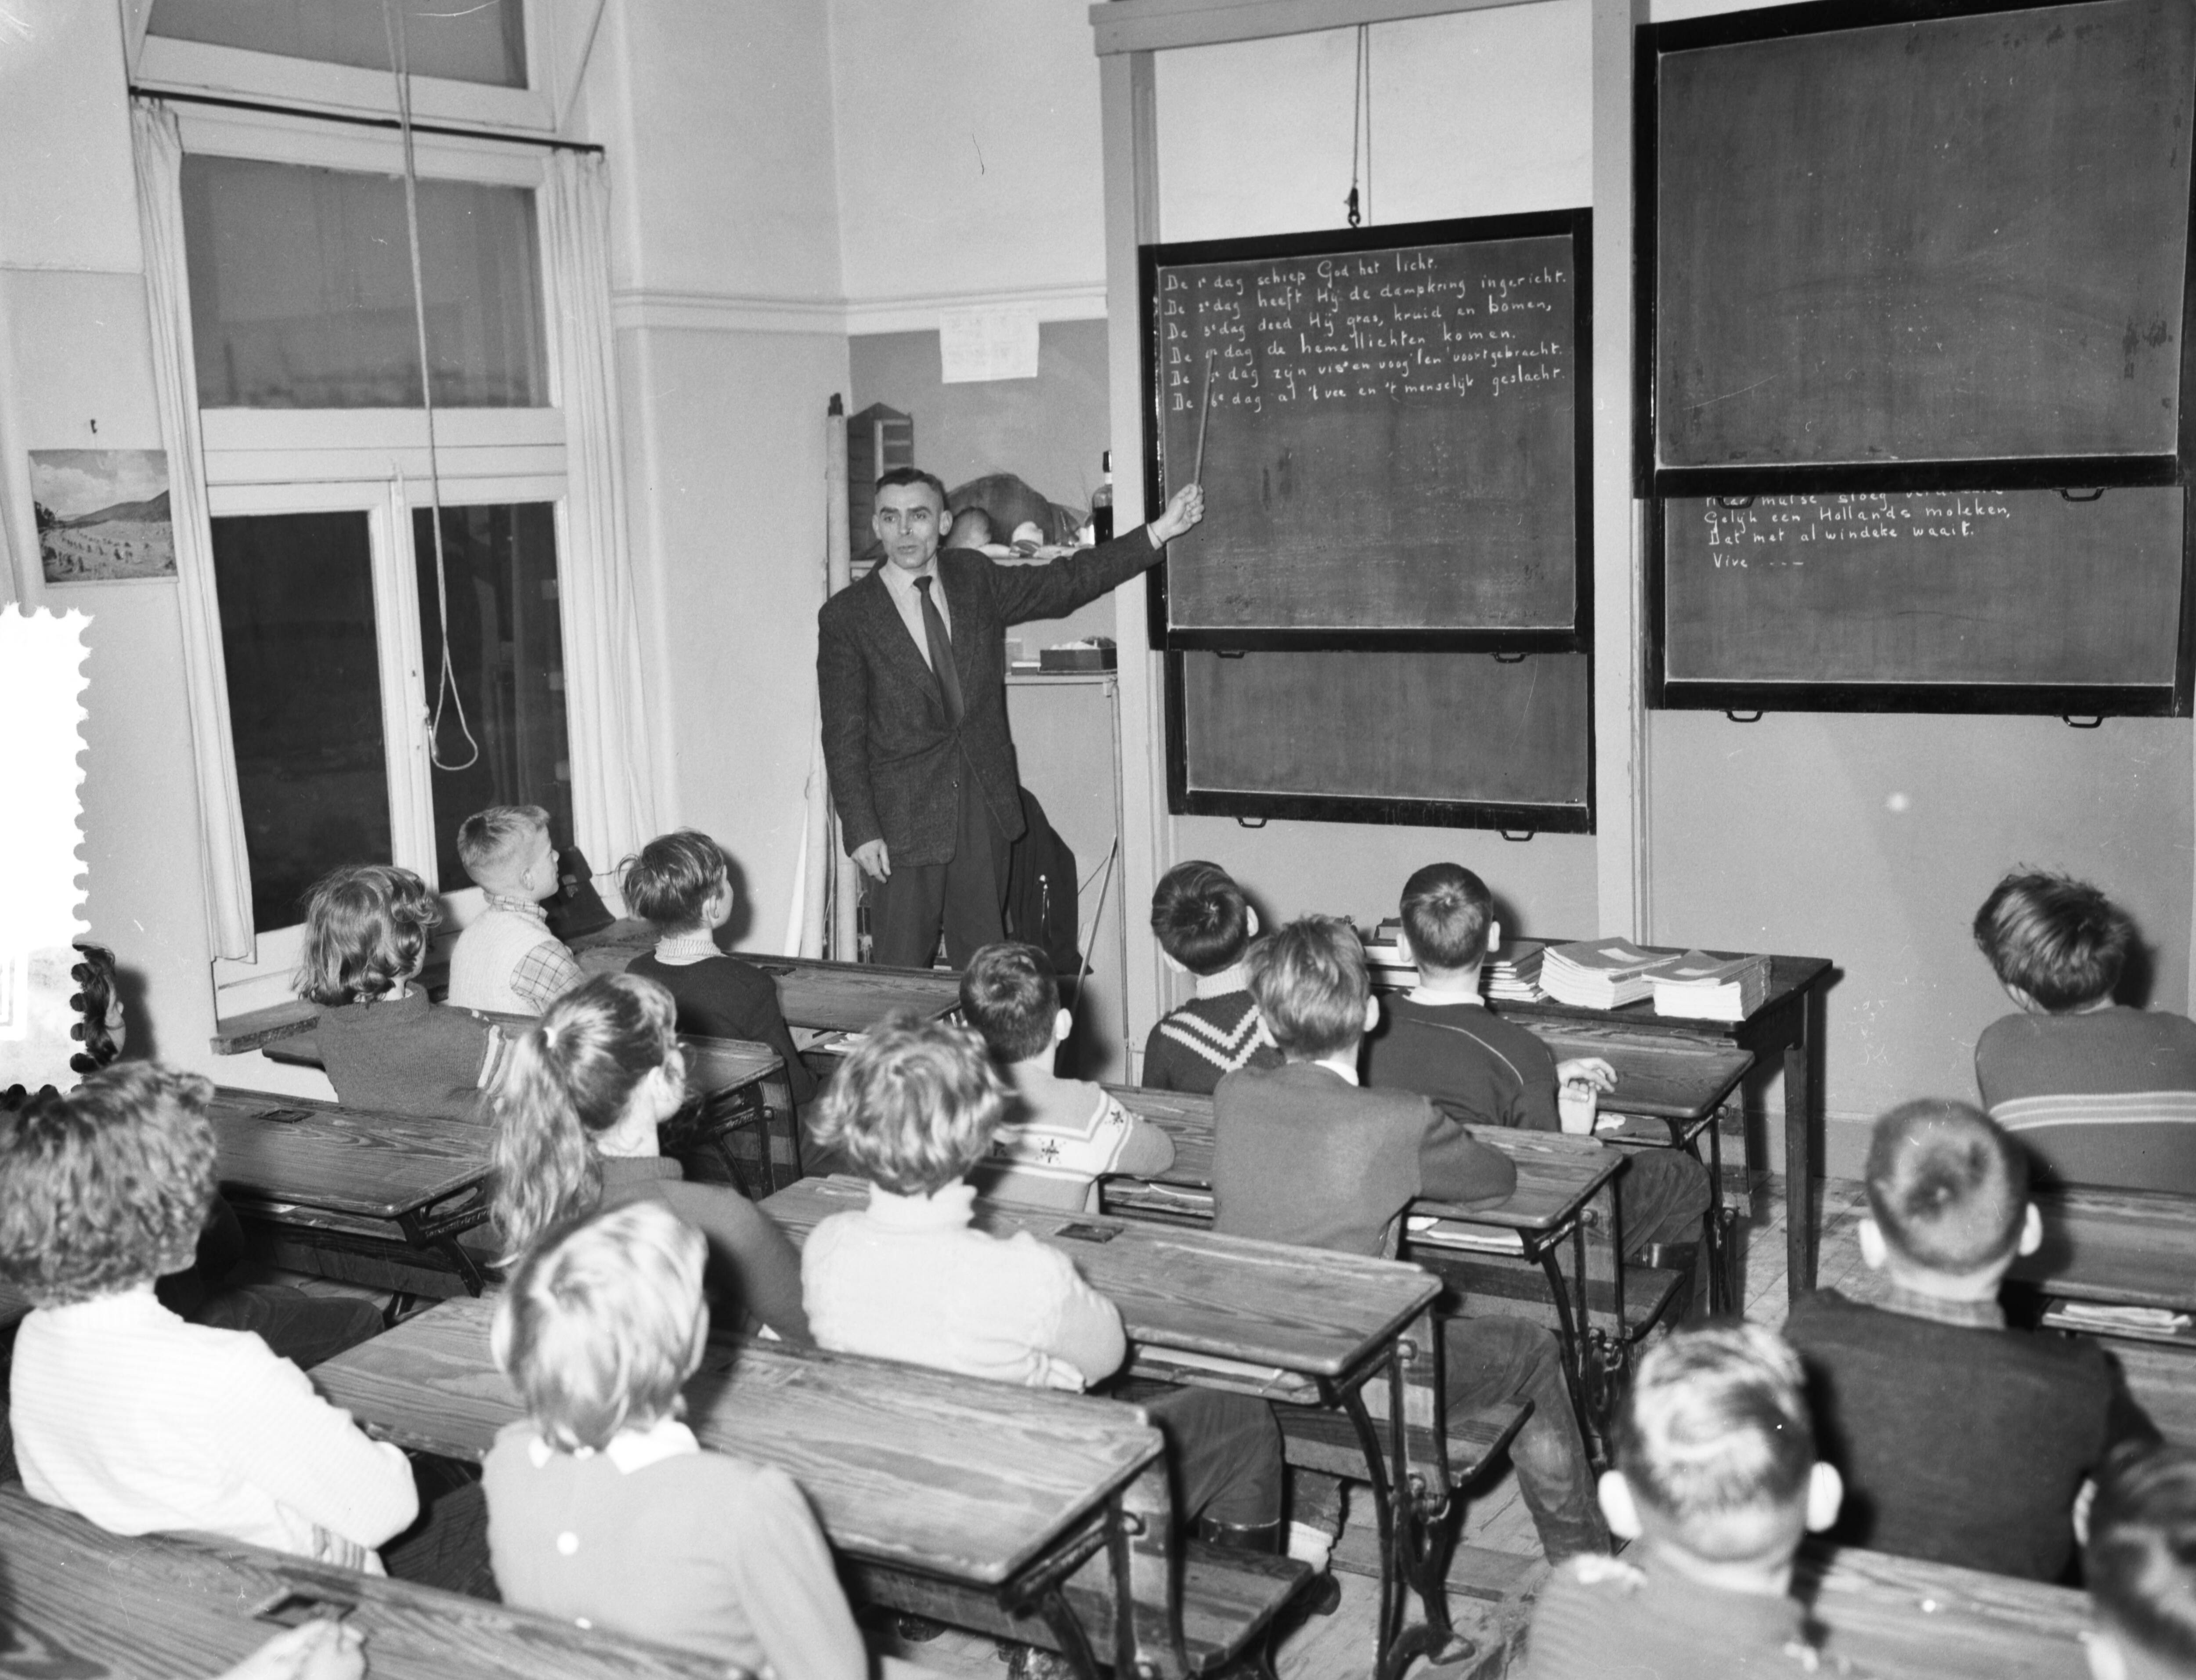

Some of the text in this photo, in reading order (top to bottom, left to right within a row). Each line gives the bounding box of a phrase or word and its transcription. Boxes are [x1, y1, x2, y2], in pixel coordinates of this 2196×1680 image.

[1164, 299, 1185, 315] De
[1214, 299, 1240, 320] dag
[1257, 286, 1301, 311] heeft
[1350, 286, 1370, 300] de
[1380, 275, 1465, 299] dampkring
[1481, 266, 1566, 298] ingericht.
[1165, 275, 1188, 291] De
[1214, 275, 1243, 296] dag
[1257, 267, 1306, 285] schiep
[1317, 260, 1349, 289] God
[1359, 258, 1380, 275] het
[1397, 252, 1438, 272] licht.
[1167, 323, 1188, 340] De
[1220, 321, 1246, 342] dag
[1258, 318, 1292, 331] deed
[1347, 314, 1383, 338] gras,
[1394, 302, 1442, 321] kruid
[1458, 307, 1475, 316] en
[1489, 294, 1551, 314] bomen,
[1170, 347, 1192, 364] De
[1224, 344, 1253, 366] dag
[1268, 340, 1286, 354] de
[1443, 321, 1515, 341] komen.
[1170, 371, 1190, 386] De
[1229, 366, 1258, 388] dag
[1274, 364, 1307, 389] zijn
[1453, 340, 1562, 367] voortgebracht.
[1172, 393, 1193, 410] De
[1232, 392, 1261, 413] dag
[1279, 380, 1296, 401] al
[1326, 389, 1346, 398] vee
[1359, 388, 1376, 396] en
[1405, 373, 1473, 396] menselijk
[1492, 363, 1564, 396] geslacht.
[1709, 520, 1974, 545] Dat met al windeke waait.
[1772, 513, 1800, 522] een
[1820, 505, 1911, 521] Hollands
[1925, 498, 2010, 518] moleken,
[1713, 553, 1748, 567] Vive
